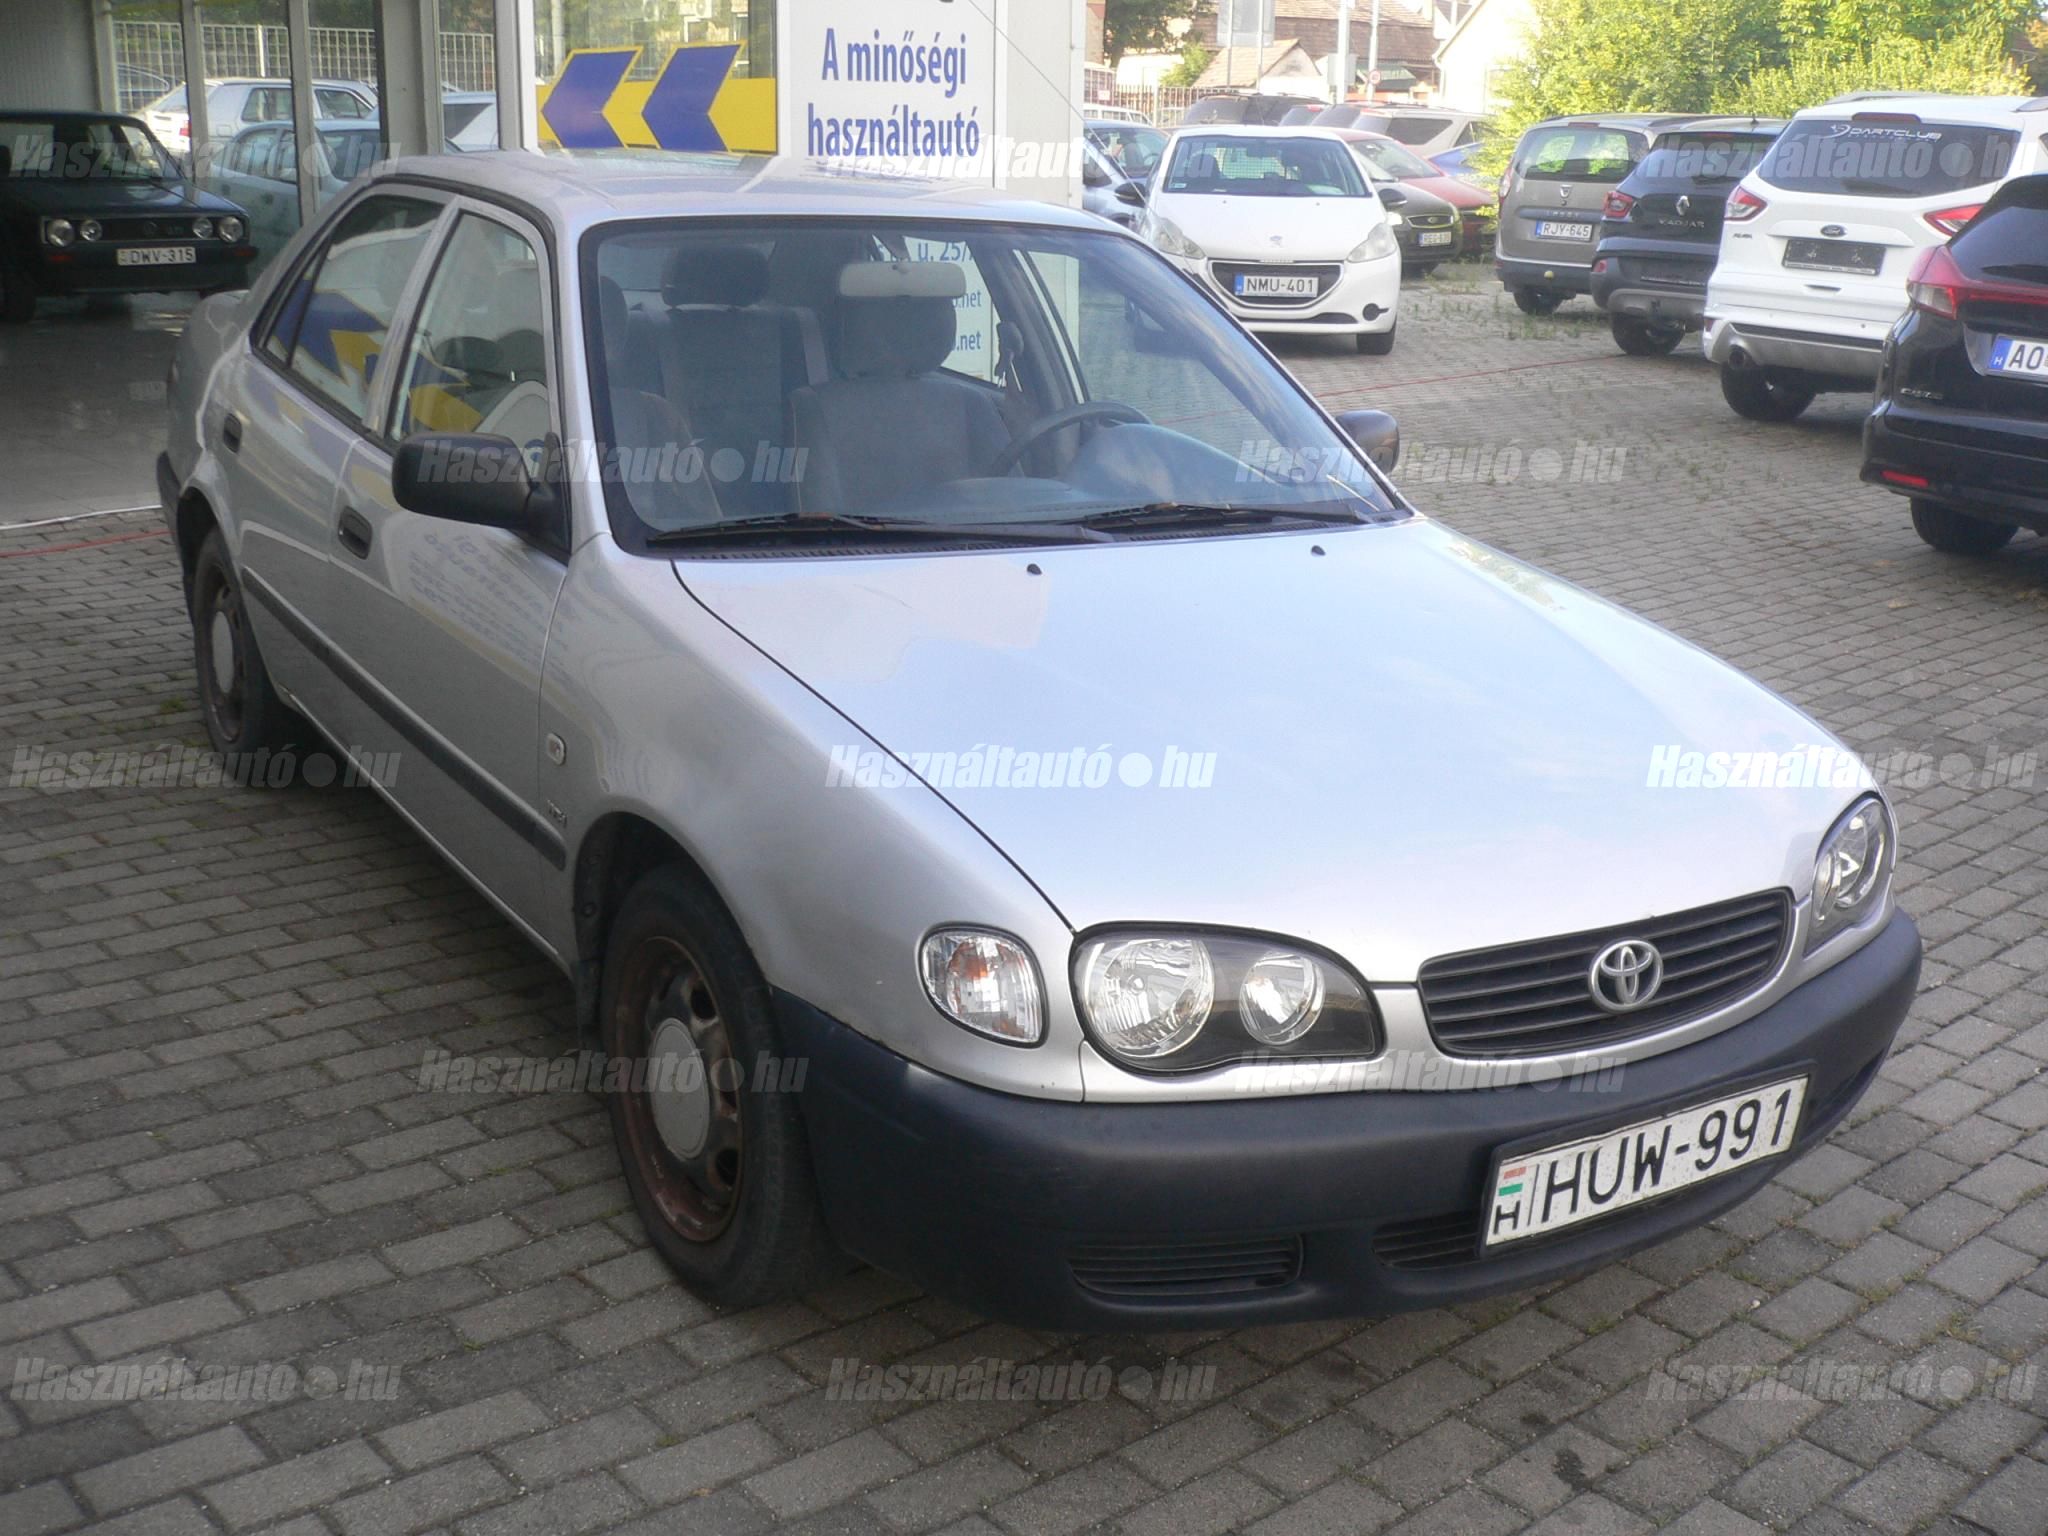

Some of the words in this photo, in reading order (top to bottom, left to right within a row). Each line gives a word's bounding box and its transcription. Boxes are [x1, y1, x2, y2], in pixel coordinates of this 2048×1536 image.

[822, 28, 839, 80] A
[847, 29, 966, 98] minőségi
[808, 103, 979, 156] használtautó
[1543, 223, 1590, 237] RJY-645
[130, 248, 194, 264] DWV-315
[1246, 277, 1314, 293] NMU-401
[1492, 1200, 1521, 1236] H
[1540, 1088, 1792, 1224] HUW-991
